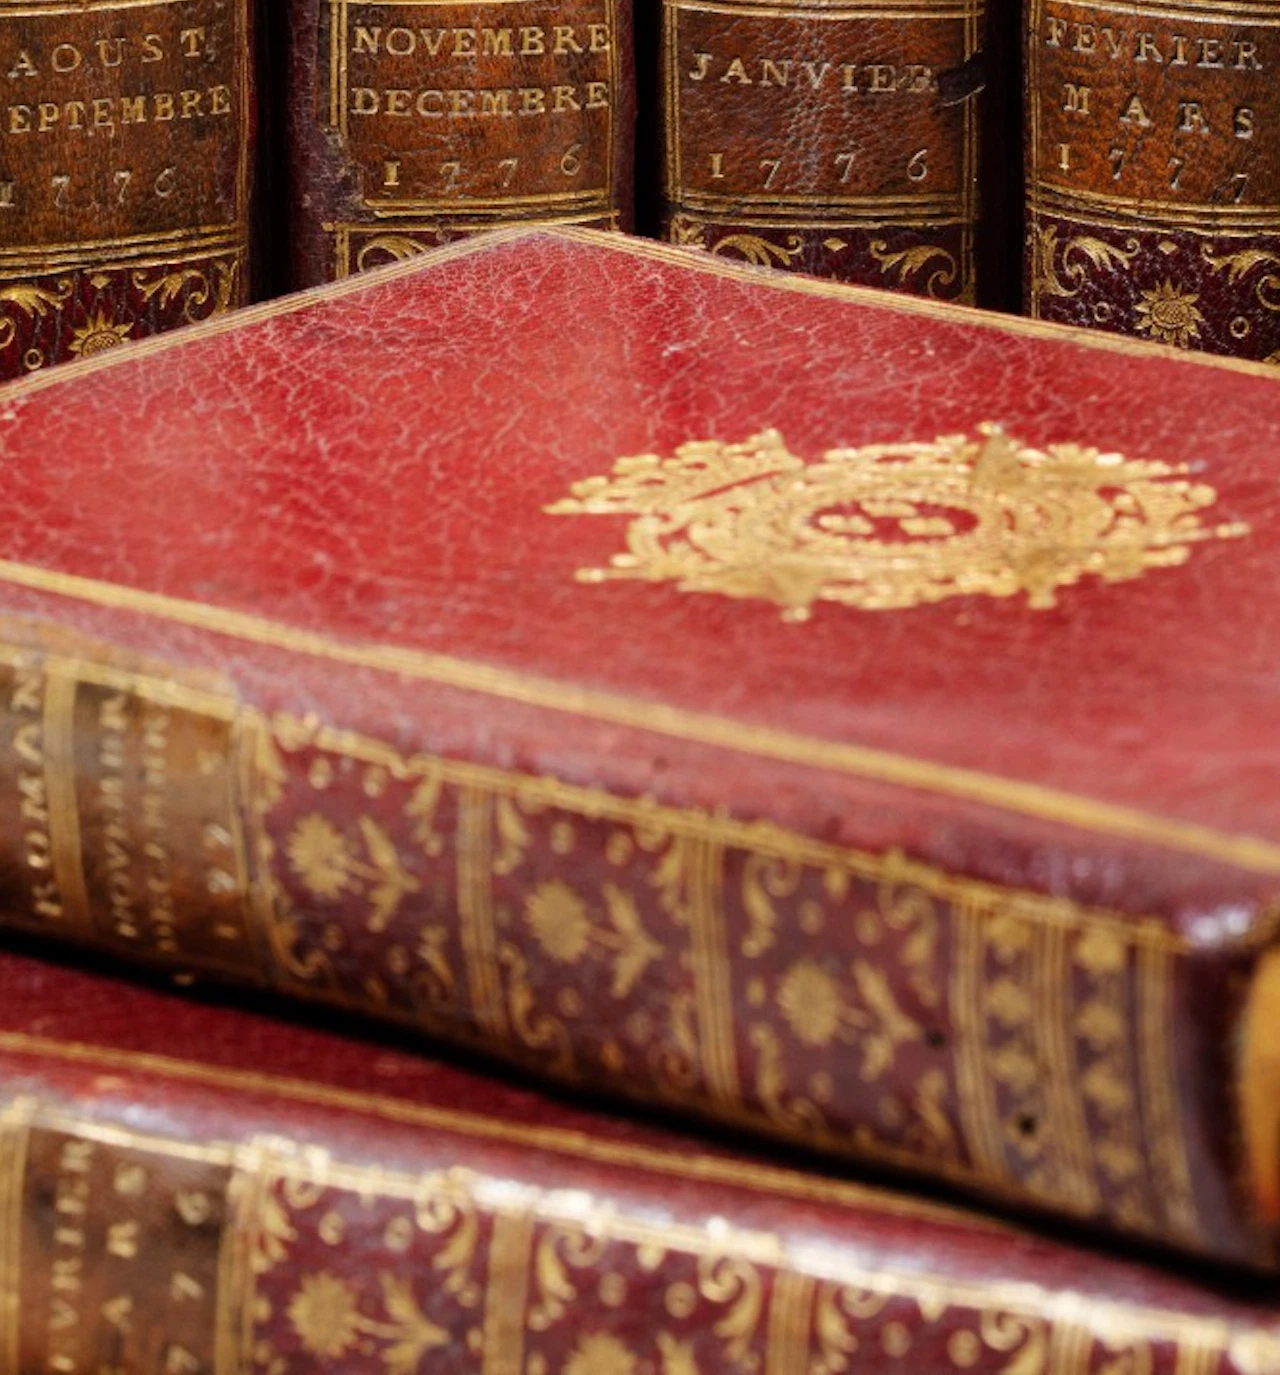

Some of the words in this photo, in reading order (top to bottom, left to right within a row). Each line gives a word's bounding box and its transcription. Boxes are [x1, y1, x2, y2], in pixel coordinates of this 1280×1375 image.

[7, 28, 206, 79] AOUST
[352, 24, 612, 56] NOVEMBRE
[1045, 16, 1263, 71] FEVRIER
[351, 81, 610, 116] DECEMBRE
[1063, 83, 1254, 140] MARS
[382, 142, 583, 188] 1776
[707, 148, 928, 190] 1776
[1057, 142, 1249, 204] 1777
